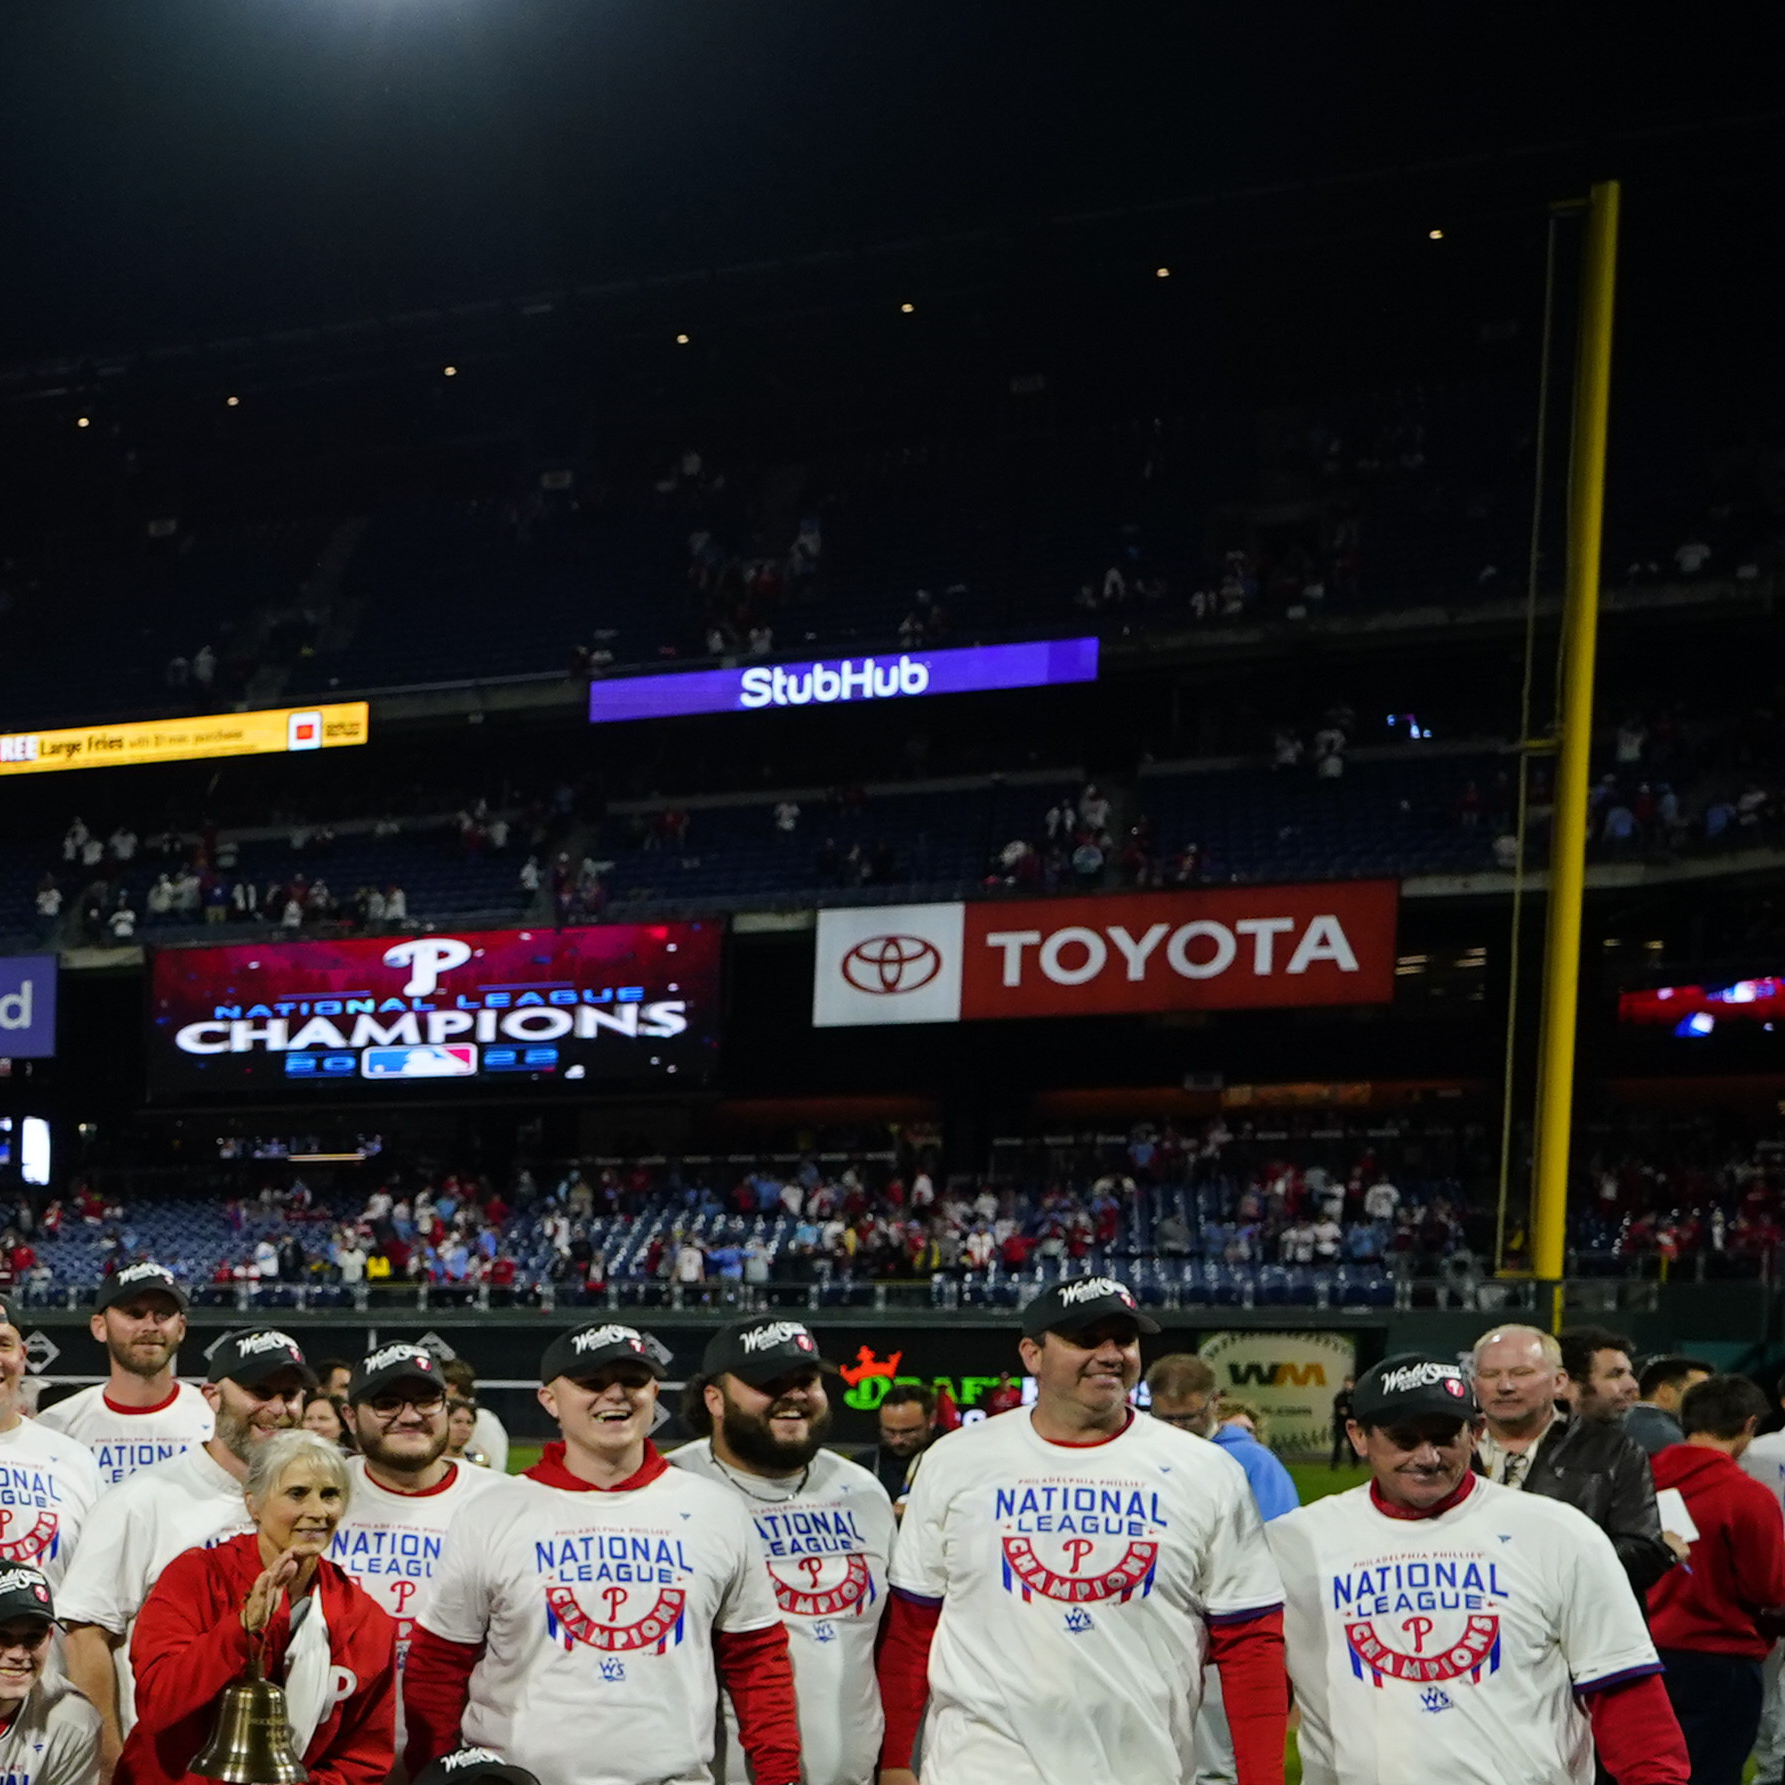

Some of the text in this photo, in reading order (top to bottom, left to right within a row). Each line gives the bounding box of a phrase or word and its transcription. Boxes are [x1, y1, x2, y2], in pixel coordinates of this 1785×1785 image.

[740, 655, 929, 708] StubHub
[40, 741, 81, 760] Large
[87, 734, 124, 753] Fries
[985, 914, 1360, 988] TOYOTA
[213, 986, 645, 1020] NATIONAL LEAGUE
[174, 1000, 688, 1054] CHAMPIONS
[1229, 1363, 1326, 1387] WM
[996, 1487, 1168, 1528] NATIONAL
[1017, 1516, 1144, 1536] LEAGUE
[536, 1536, 694, 1574] NATIONAL
[558, 1564, 674, 1584] LEAGUE
[1334, 1562, 1508, 1610] NATIONAL
[1357, 1595, 1483, 1618] LEAGUE
